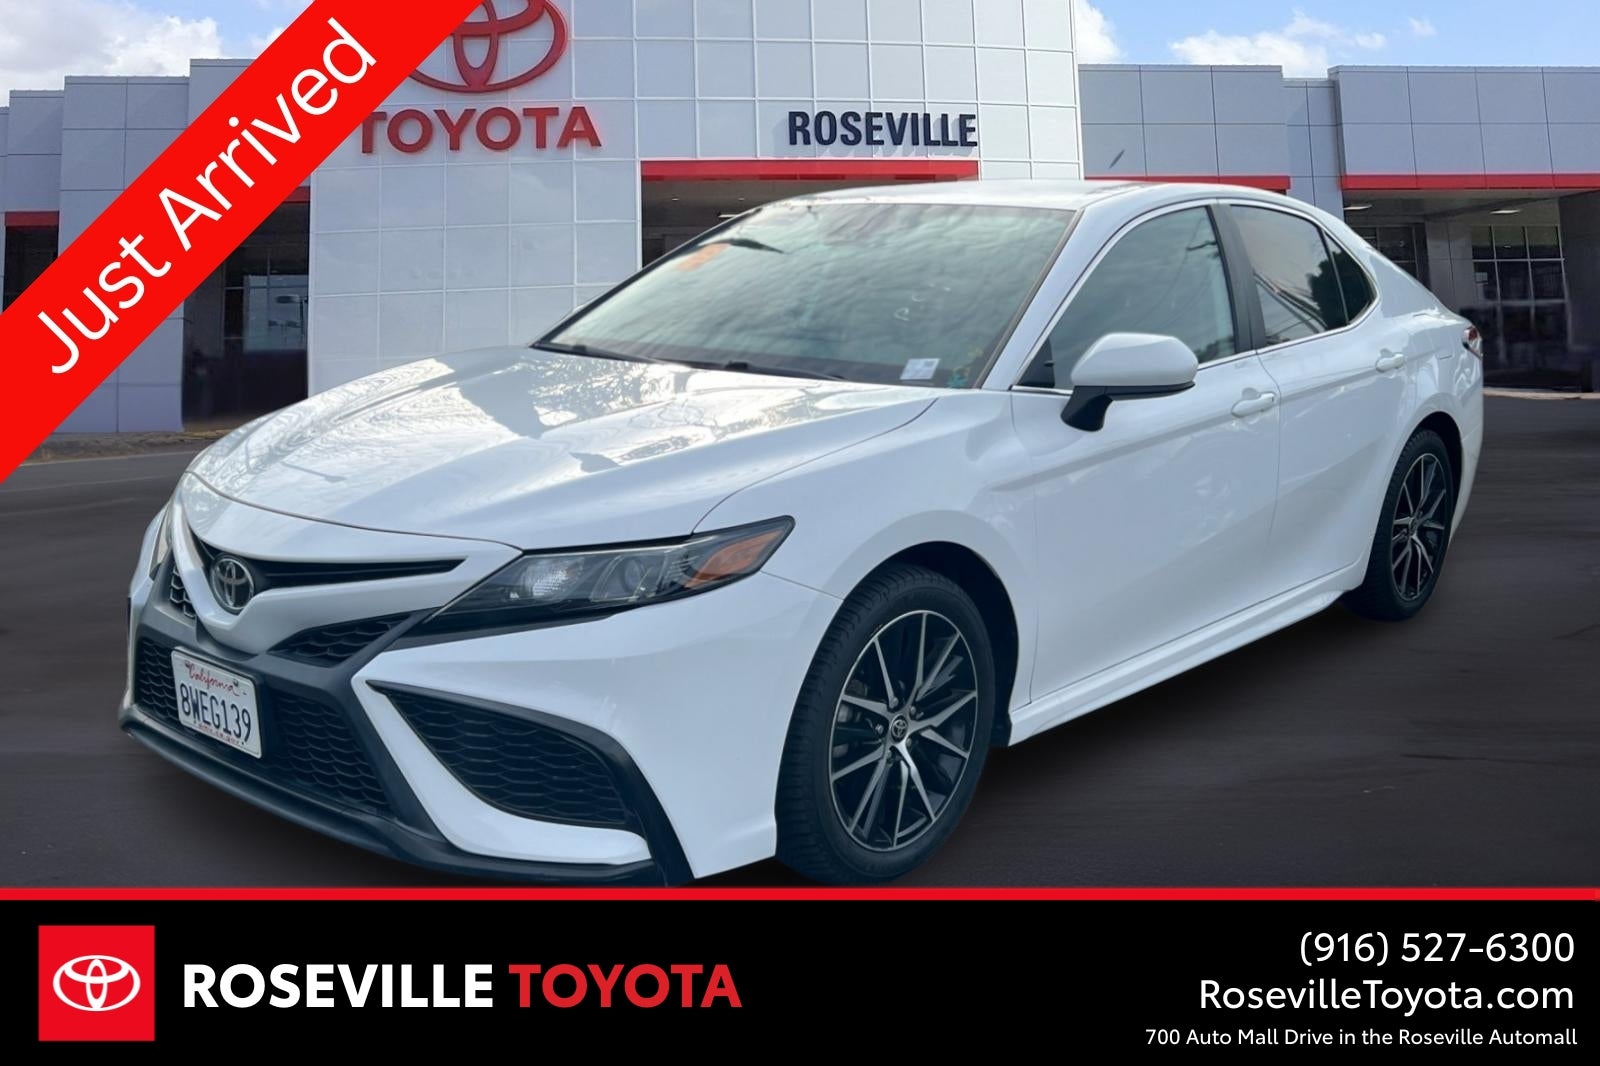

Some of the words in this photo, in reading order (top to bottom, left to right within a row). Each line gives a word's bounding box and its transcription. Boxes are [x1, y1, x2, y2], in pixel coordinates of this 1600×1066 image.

[361, 106, 602, 154] TOYOTA
[788, 111, 978, 147] ROSEVILLE
[180, 683, 252, 743] 8WEG139
